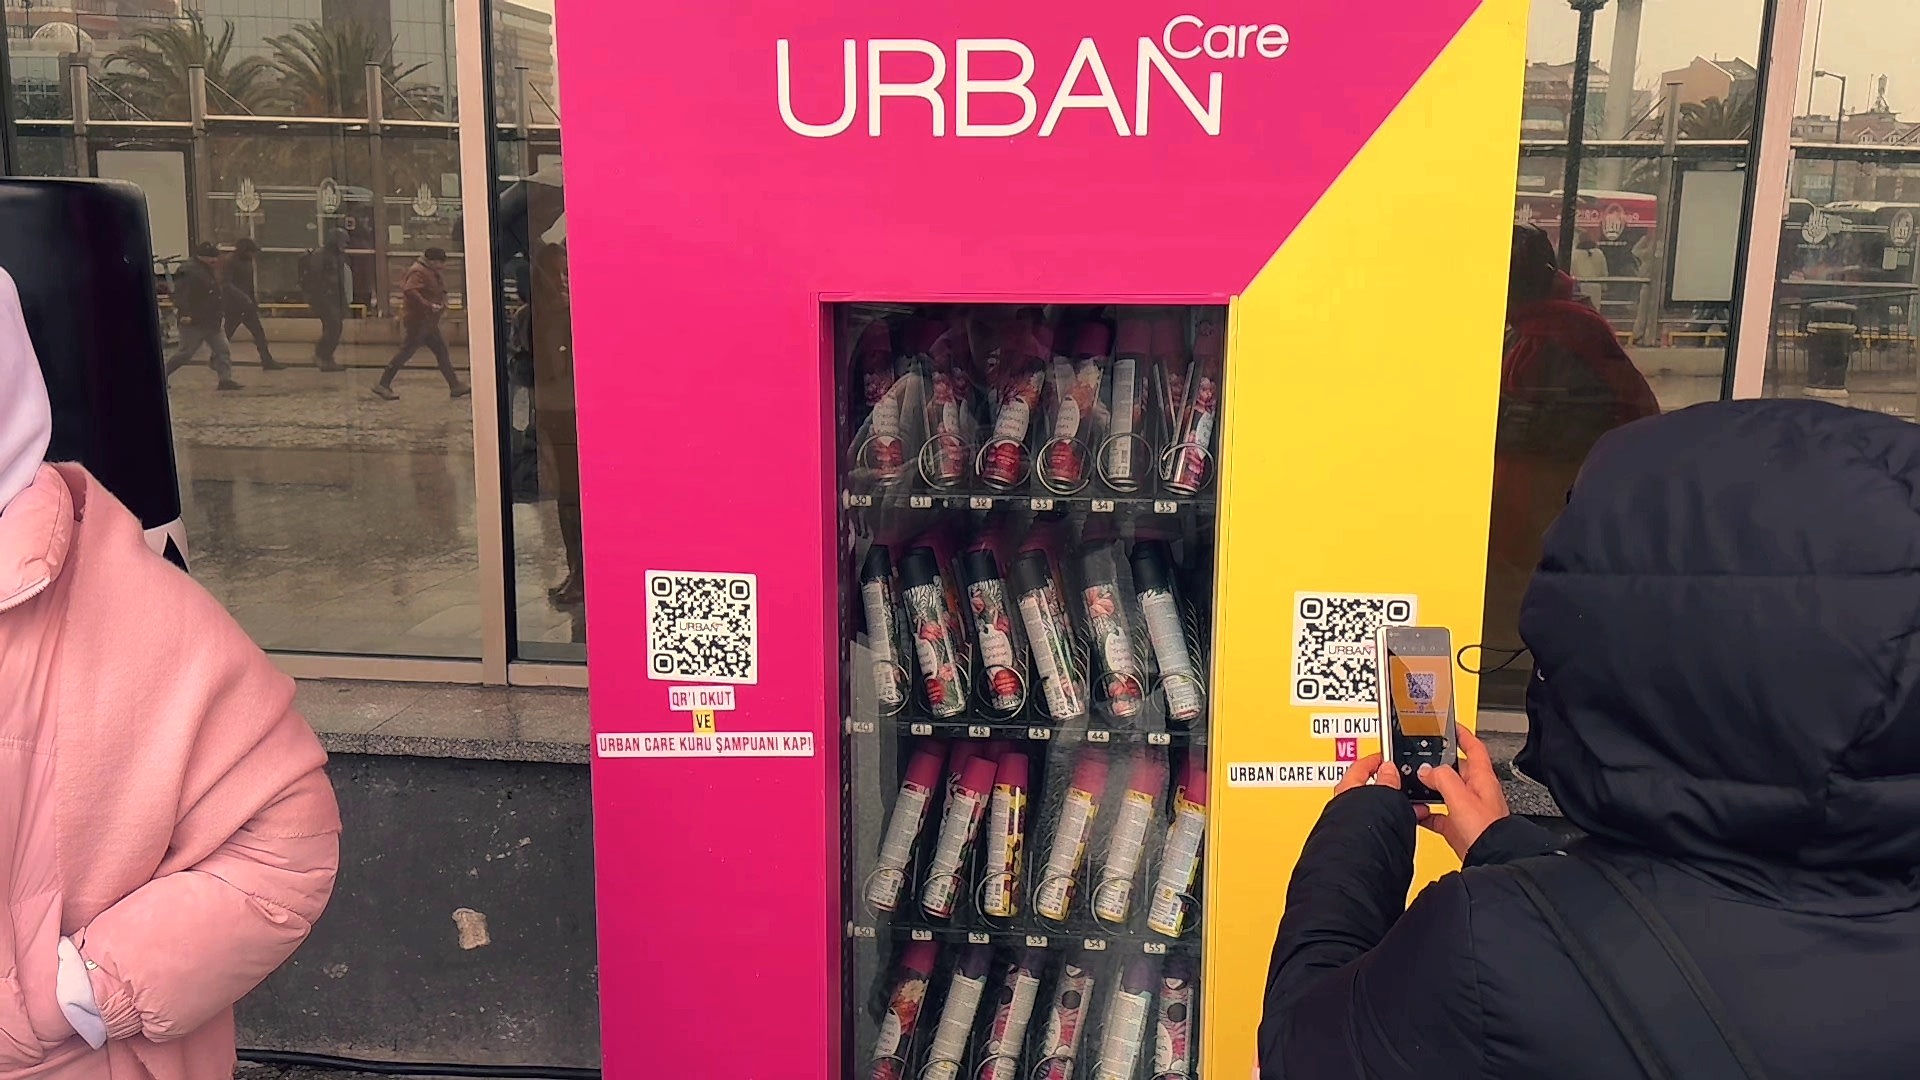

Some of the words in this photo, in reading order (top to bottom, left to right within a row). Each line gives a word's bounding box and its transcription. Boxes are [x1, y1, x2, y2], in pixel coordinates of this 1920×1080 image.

[775, 36, 1223, 138] URBAN
[1163, 14, 1290, 61] Care
[679, 620, 719, 632] URBAN
[1328, 644, 1372, 656] URBAN
[671, 691, 697, 707] QR'I
[699, 690, 732, 706] OKUT
[695, 713, 712, 729] VE
[1312, 718, 1339, 735] QR'I
[1343, 718, 1379, 734] OKUT
[599, 737, 640, 752] URBAN
[644, 736, 676, 751] CARE
[679, 736, 712, 751] KURU
[715, 736, 779, 754] ŞAMPUANI
[783, 736, 812, 751] KAP!
[1337, 741, 1356, 758] VE
[1230, 766, 1274, 782] URBAN
[1279, 766, 1313, 781] CARE
